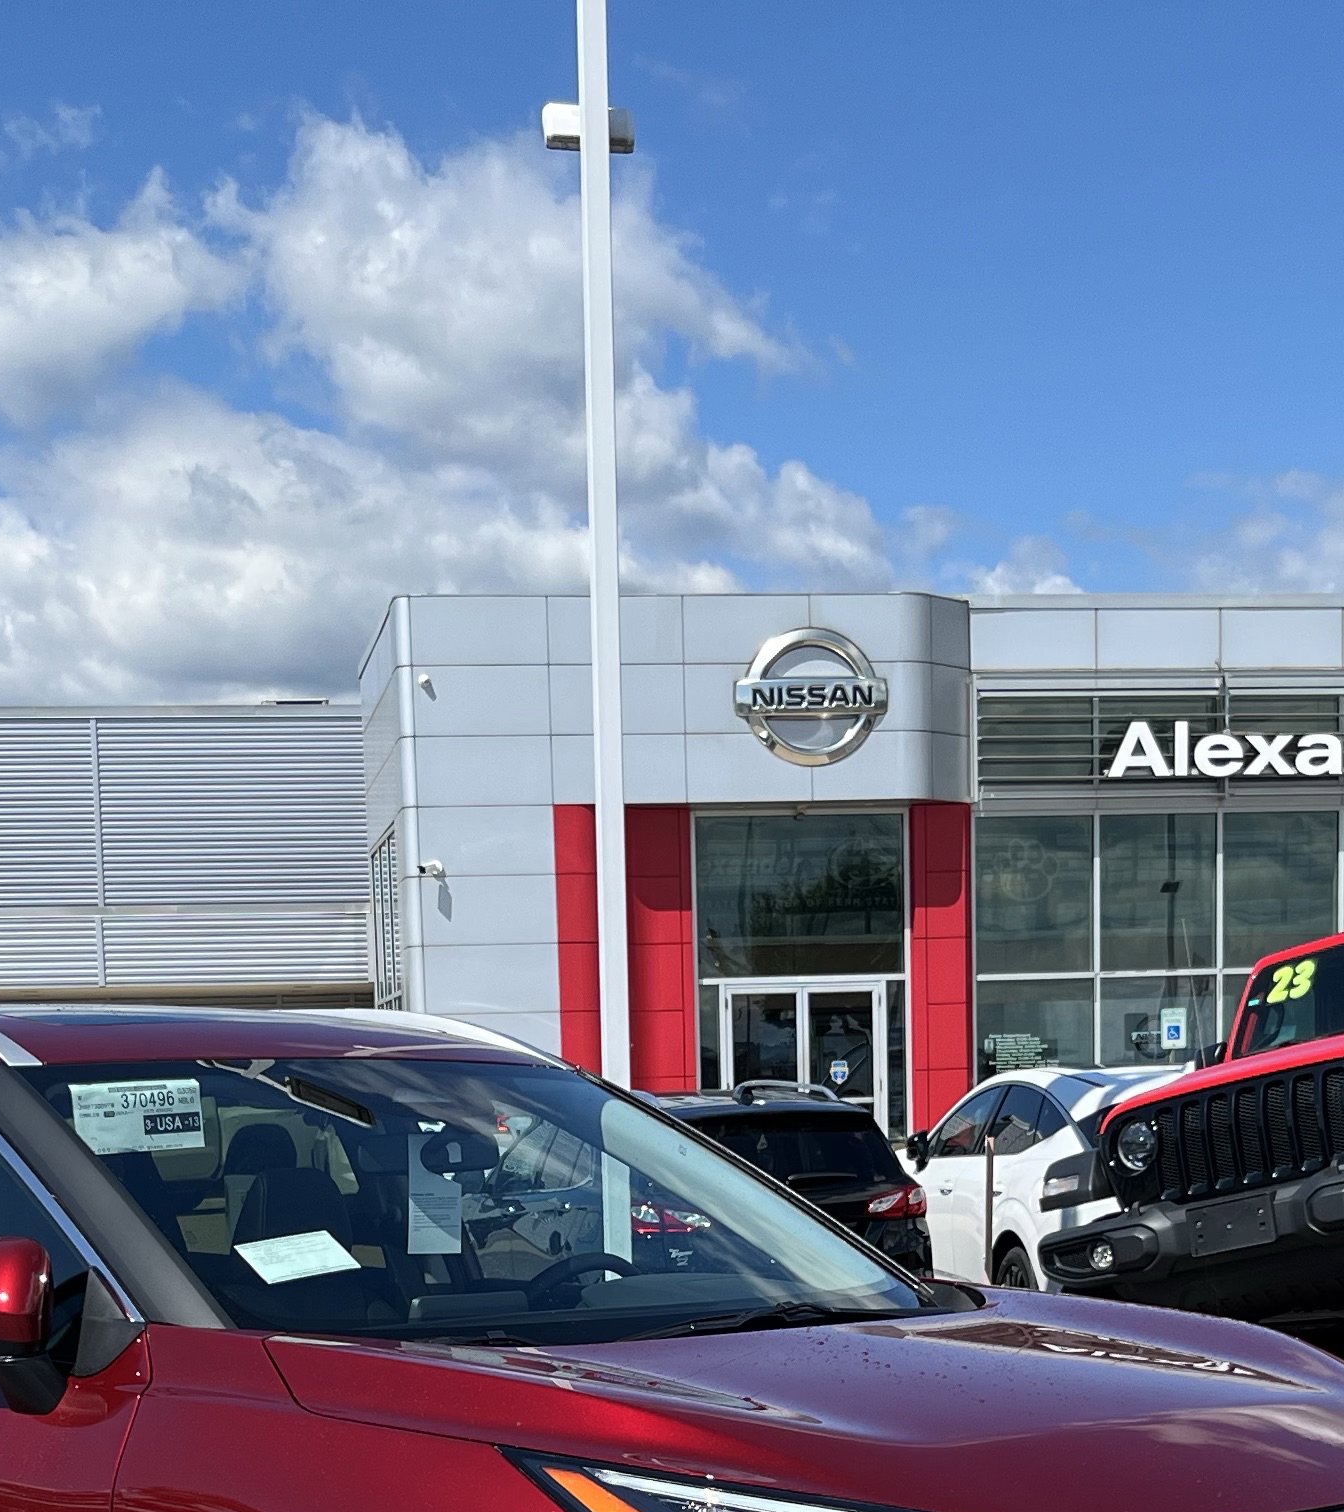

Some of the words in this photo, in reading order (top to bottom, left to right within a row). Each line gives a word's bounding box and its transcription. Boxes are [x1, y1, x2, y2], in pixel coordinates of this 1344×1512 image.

[751, 684, 875, 710] NISSAN
[1266, 959, 1315, 1004] 23
[120, 1090, 175, 1109] 370496
[157, 1116, 183, 1131] USA
